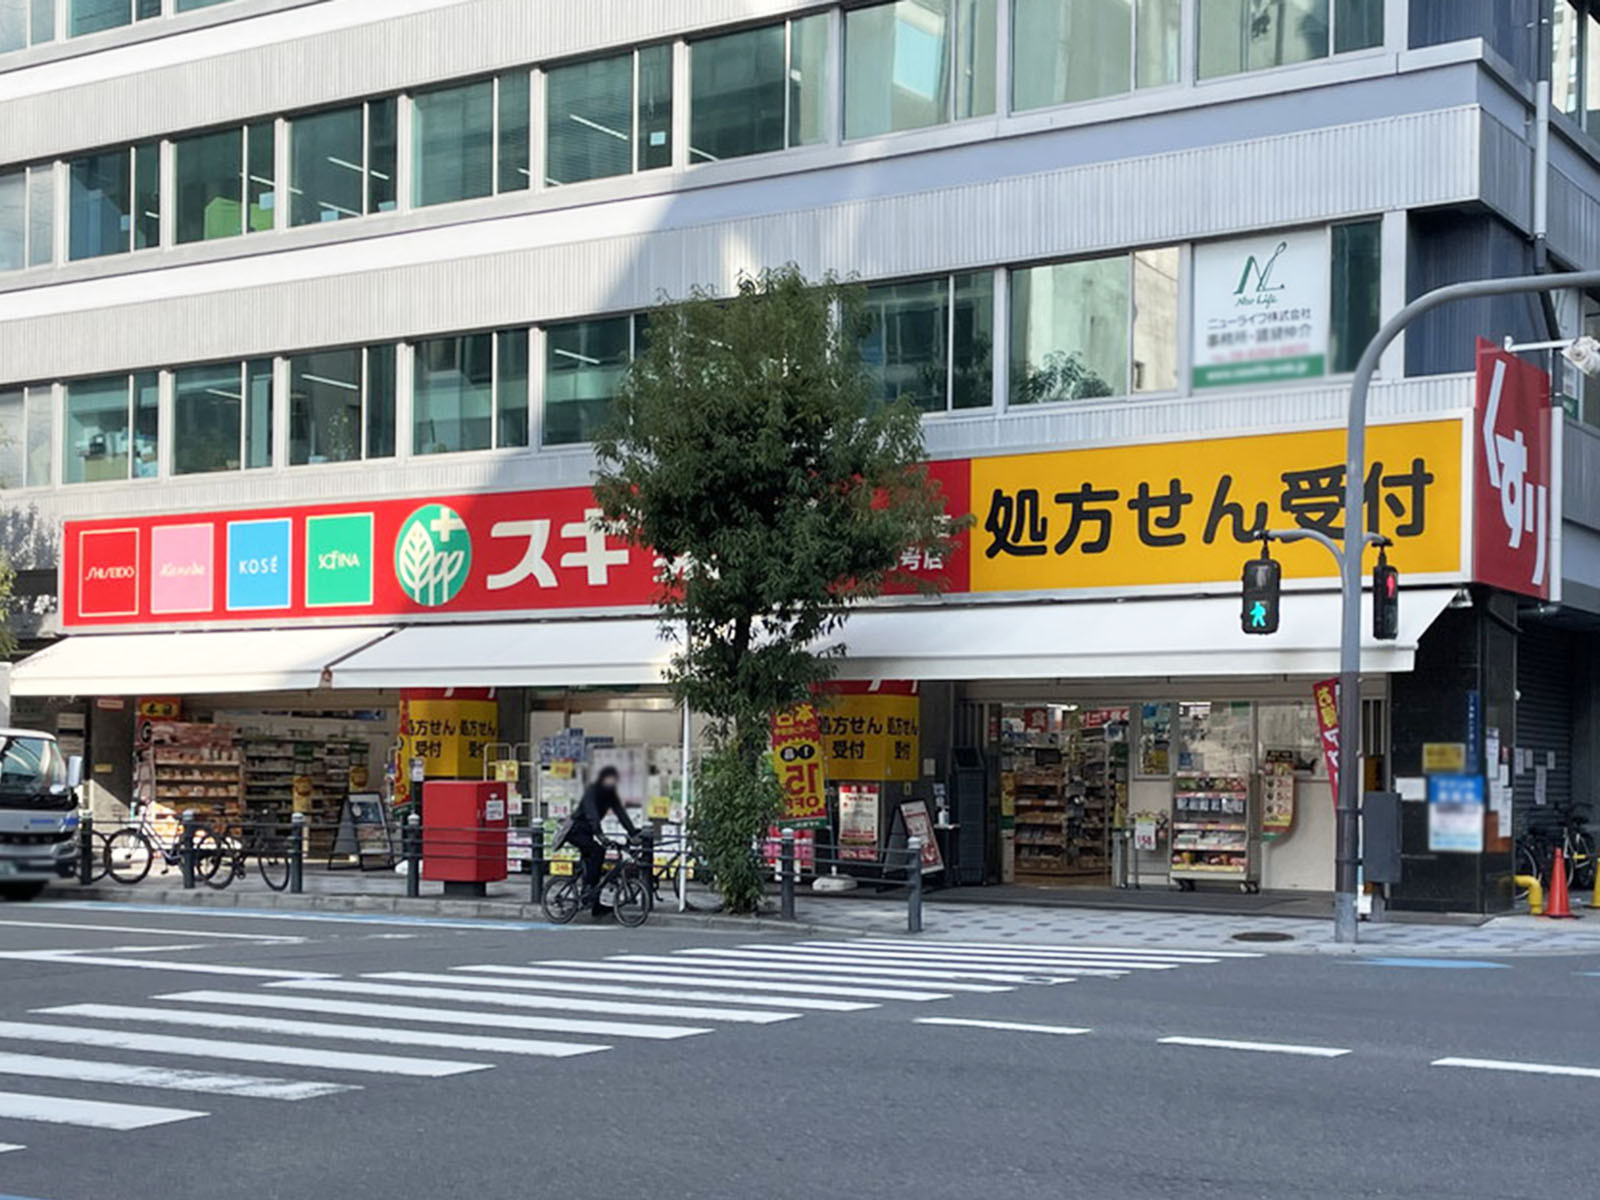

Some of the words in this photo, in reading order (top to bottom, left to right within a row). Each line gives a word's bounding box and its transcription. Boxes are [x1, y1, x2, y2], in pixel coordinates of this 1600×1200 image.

[1483, 358, 1546, 586] くすり
[984, 458, 1434, 559] 処方せん受付
[238, 554, 278, 575] KOSÉ
[317, 550, 361, 570] SOFINA
[84, 565, 136, 581] SHISEIDO
[832, 740, 865, 759] 受付
